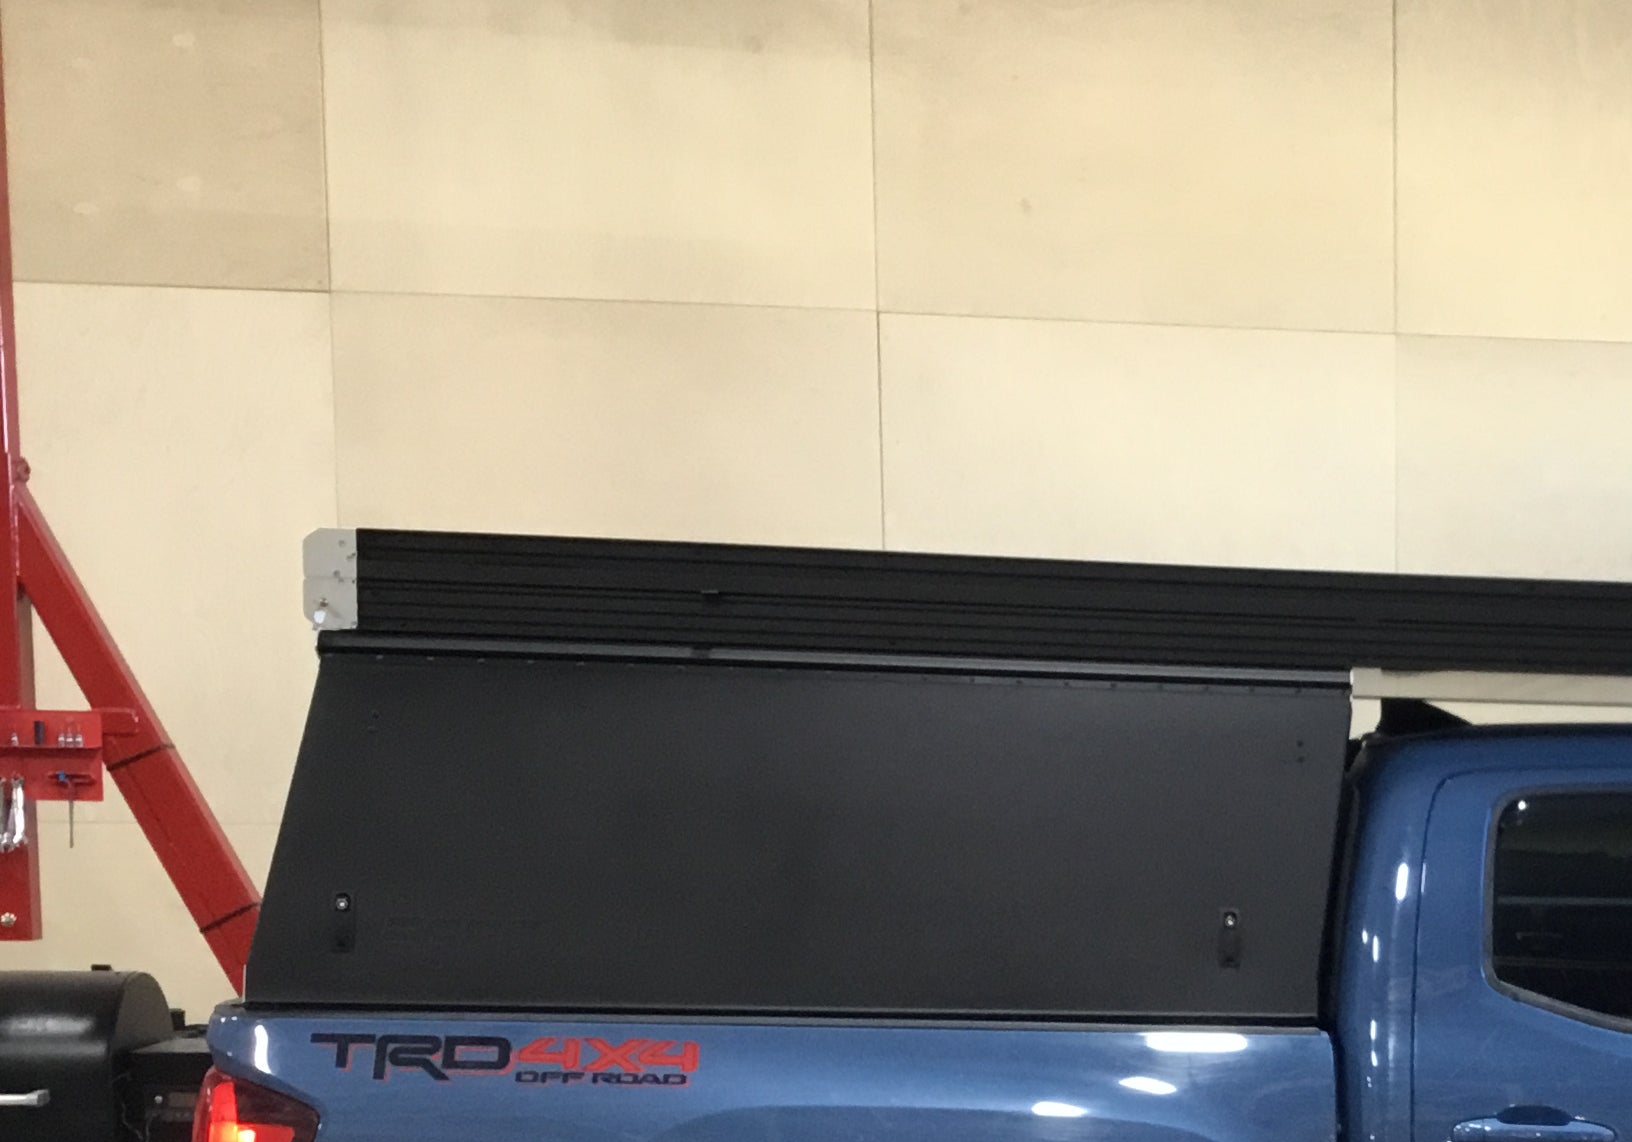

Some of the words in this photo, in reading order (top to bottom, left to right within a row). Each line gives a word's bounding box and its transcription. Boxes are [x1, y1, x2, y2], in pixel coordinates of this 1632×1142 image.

[310, 1033, 513, 1081] TRD
[517, 1037, 699, 1073] 4X4
[514, 1070, 585, 1084] OFF
[591, 1072, 689, 1086] ROAD
